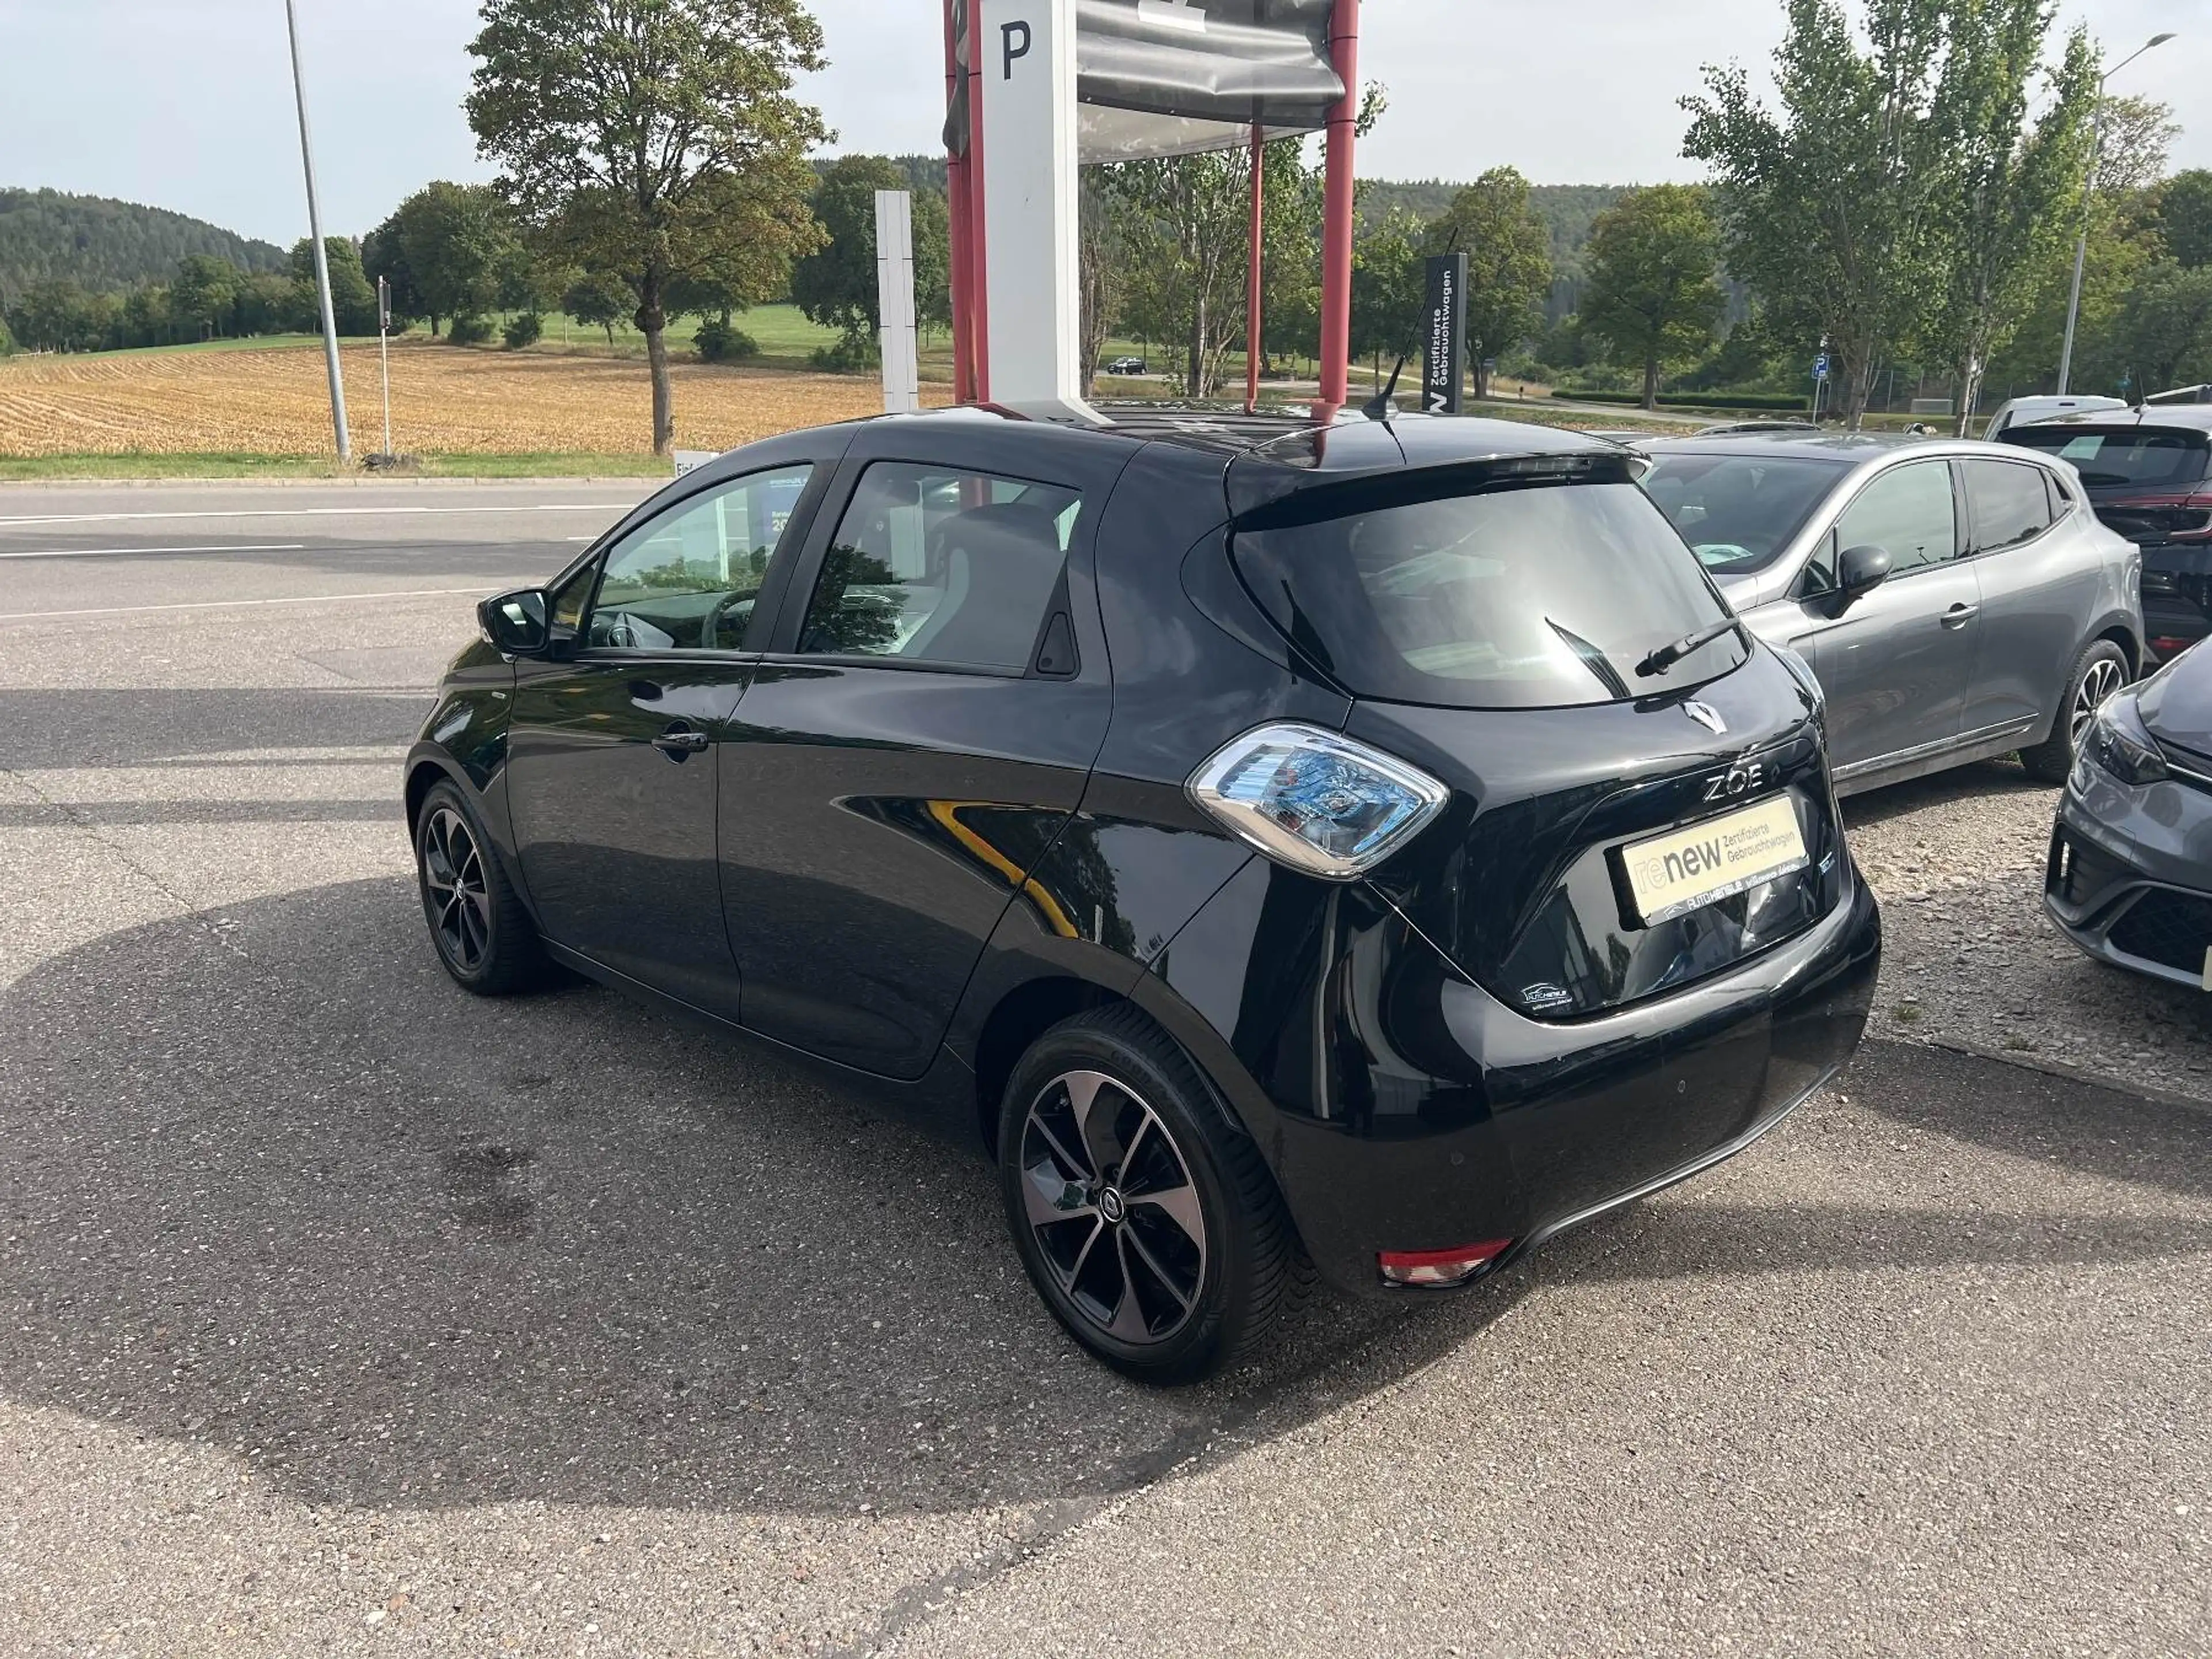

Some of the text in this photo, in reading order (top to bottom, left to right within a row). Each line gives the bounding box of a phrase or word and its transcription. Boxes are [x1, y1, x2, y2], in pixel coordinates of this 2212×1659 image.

[1000, 21, 1031, 80] P
[1430, 308, 1441, 386] Zertifizierte
[1440, 270, 1452, 386] Gebrauchtwagen
[1722, 823, 1770, 847] Zertifizierte
[1728, 831, 1796, 863] Gebrauchtwagen
[1633, 838, 1722, 894] renew
